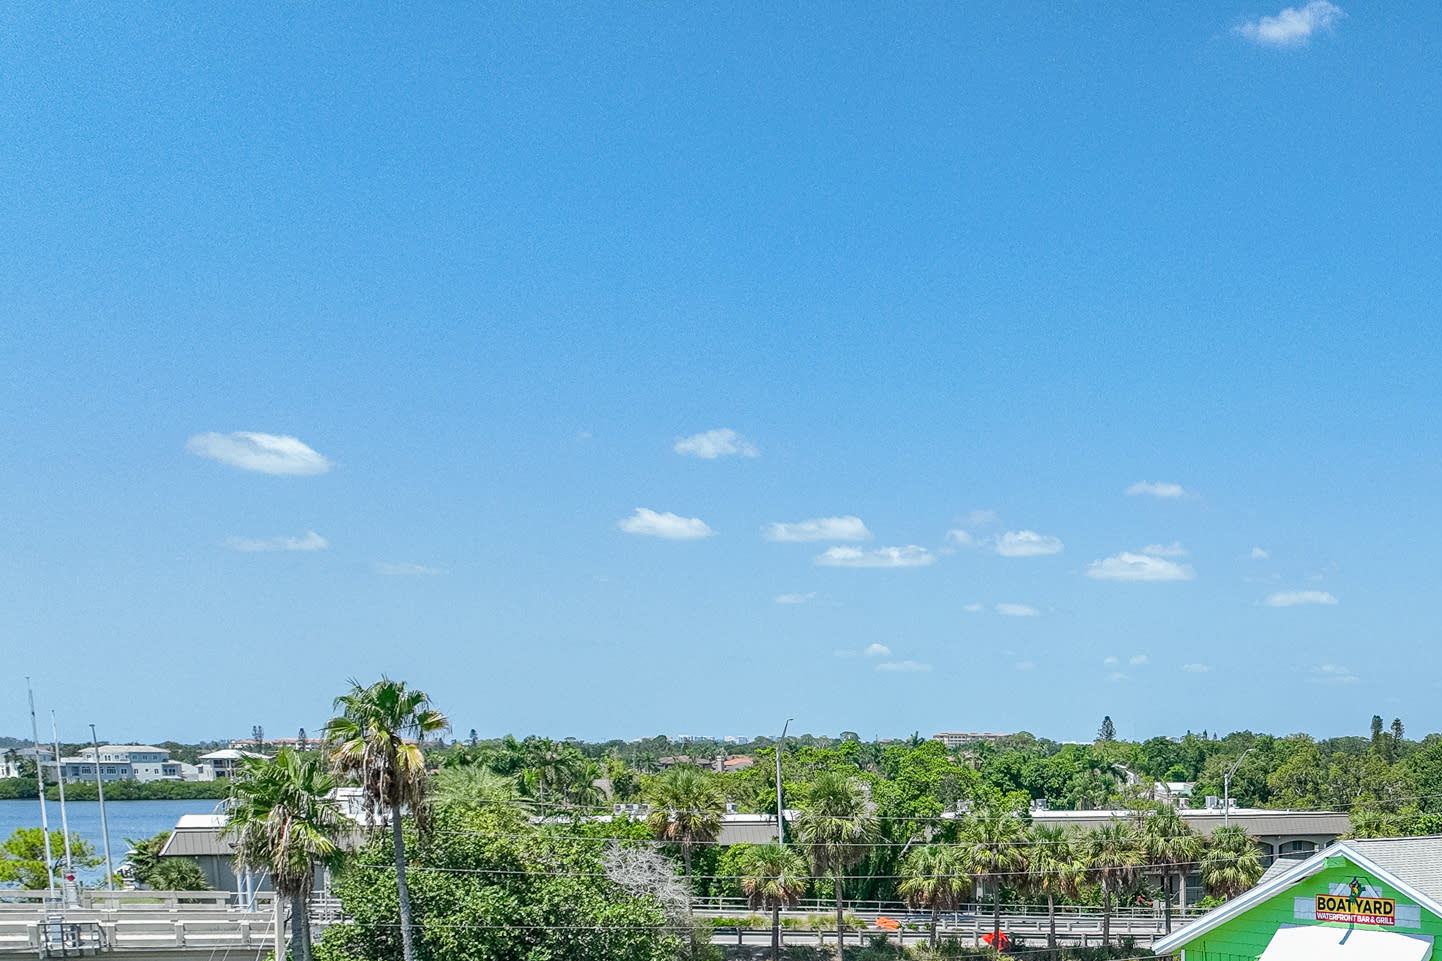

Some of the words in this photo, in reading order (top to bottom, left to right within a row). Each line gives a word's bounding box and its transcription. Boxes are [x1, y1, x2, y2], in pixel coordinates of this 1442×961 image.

[1317, 896, 1393, 915] BOATYARD
[1317, 913, 1356, 922] WATERFRONT
[1357, 915, 1370, 923] BAR
[1375, 916, 1394, 925] GRILL
